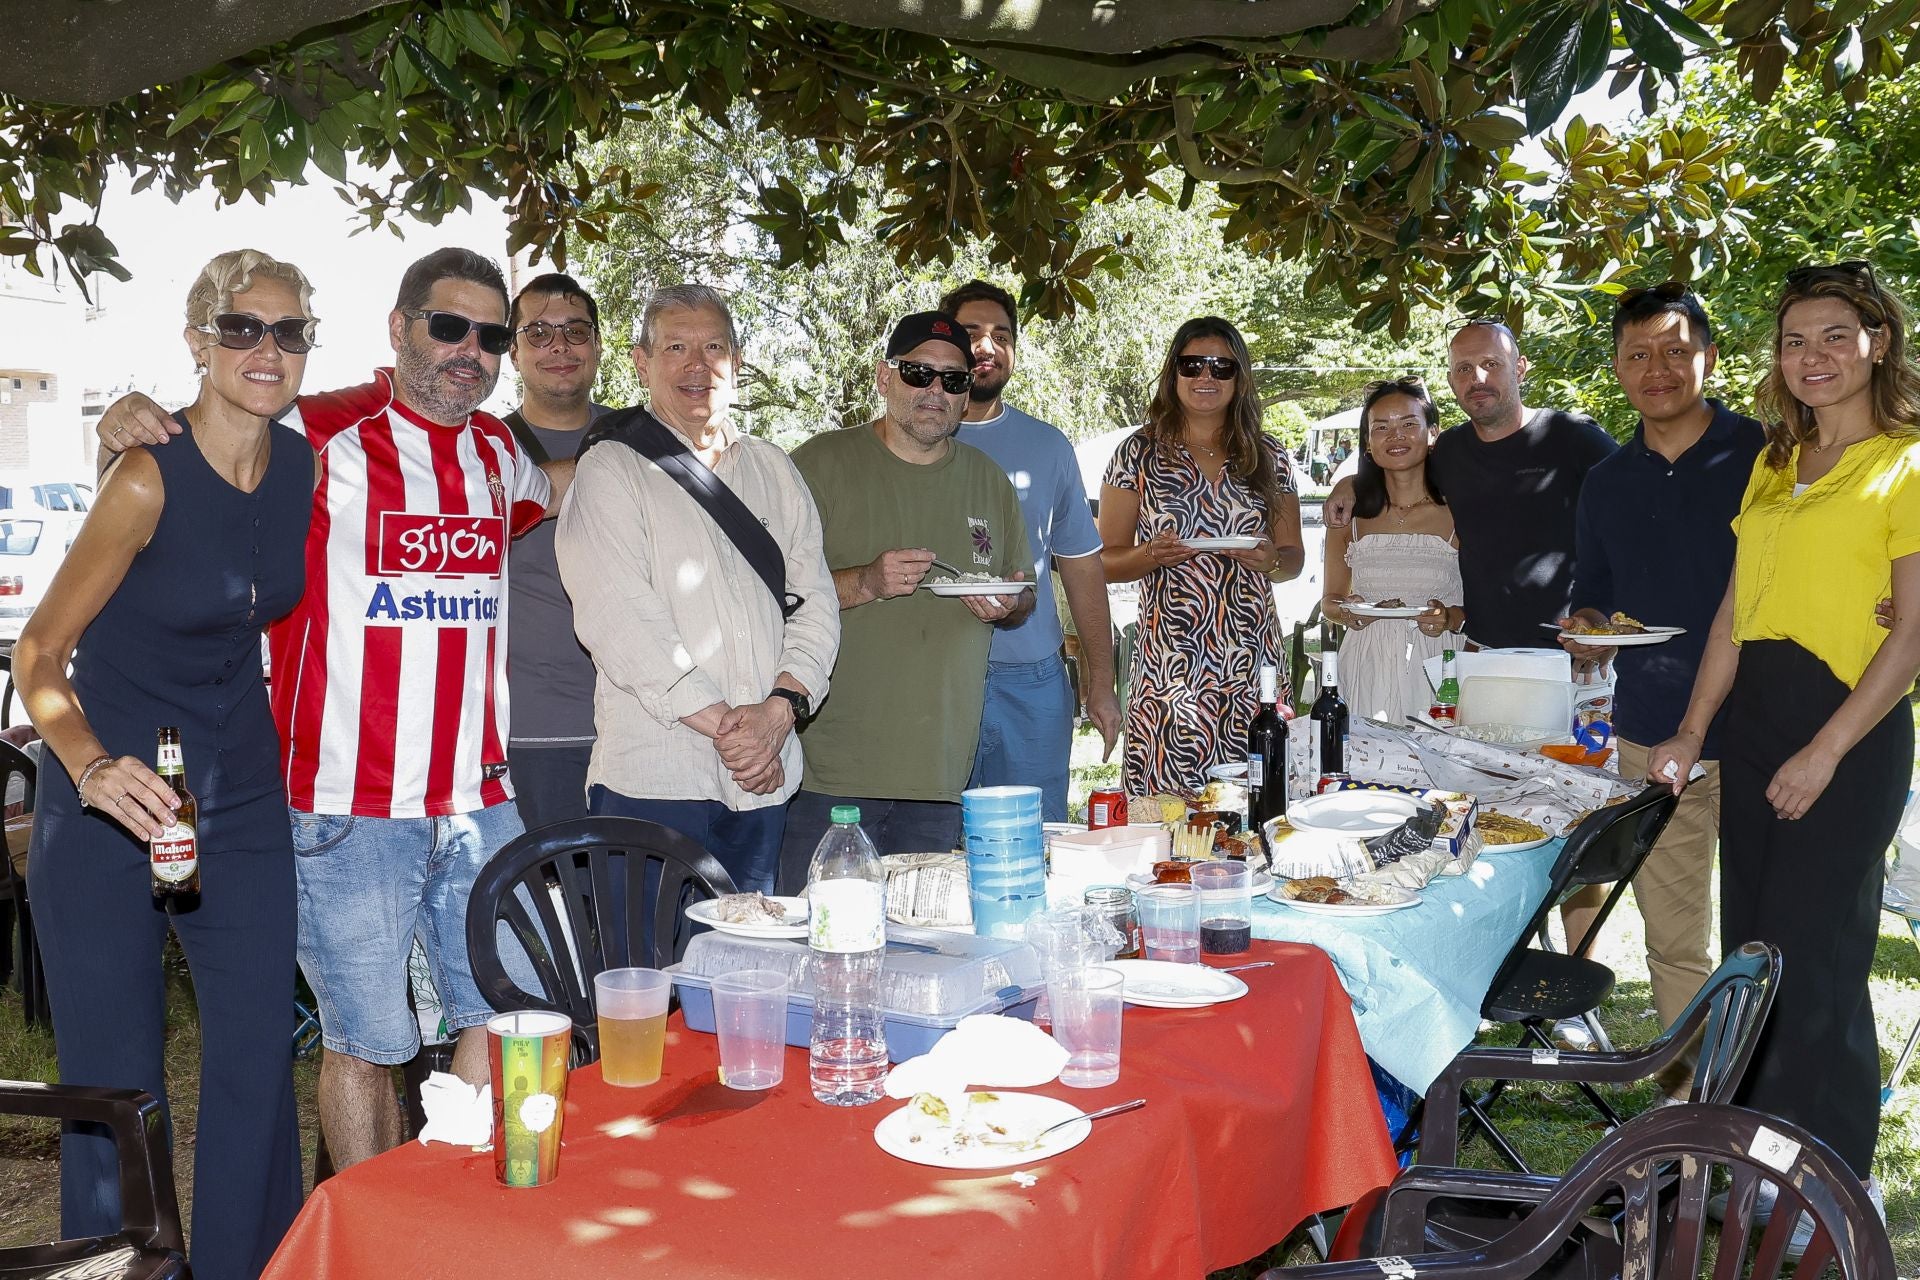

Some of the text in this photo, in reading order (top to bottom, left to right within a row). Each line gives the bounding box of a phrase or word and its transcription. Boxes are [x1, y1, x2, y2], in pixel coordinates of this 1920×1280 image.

[399, 518, 496, 572] gijón
[365, 581, 499, 622] Asturias
[154, 843, 192, 855] Mahou
